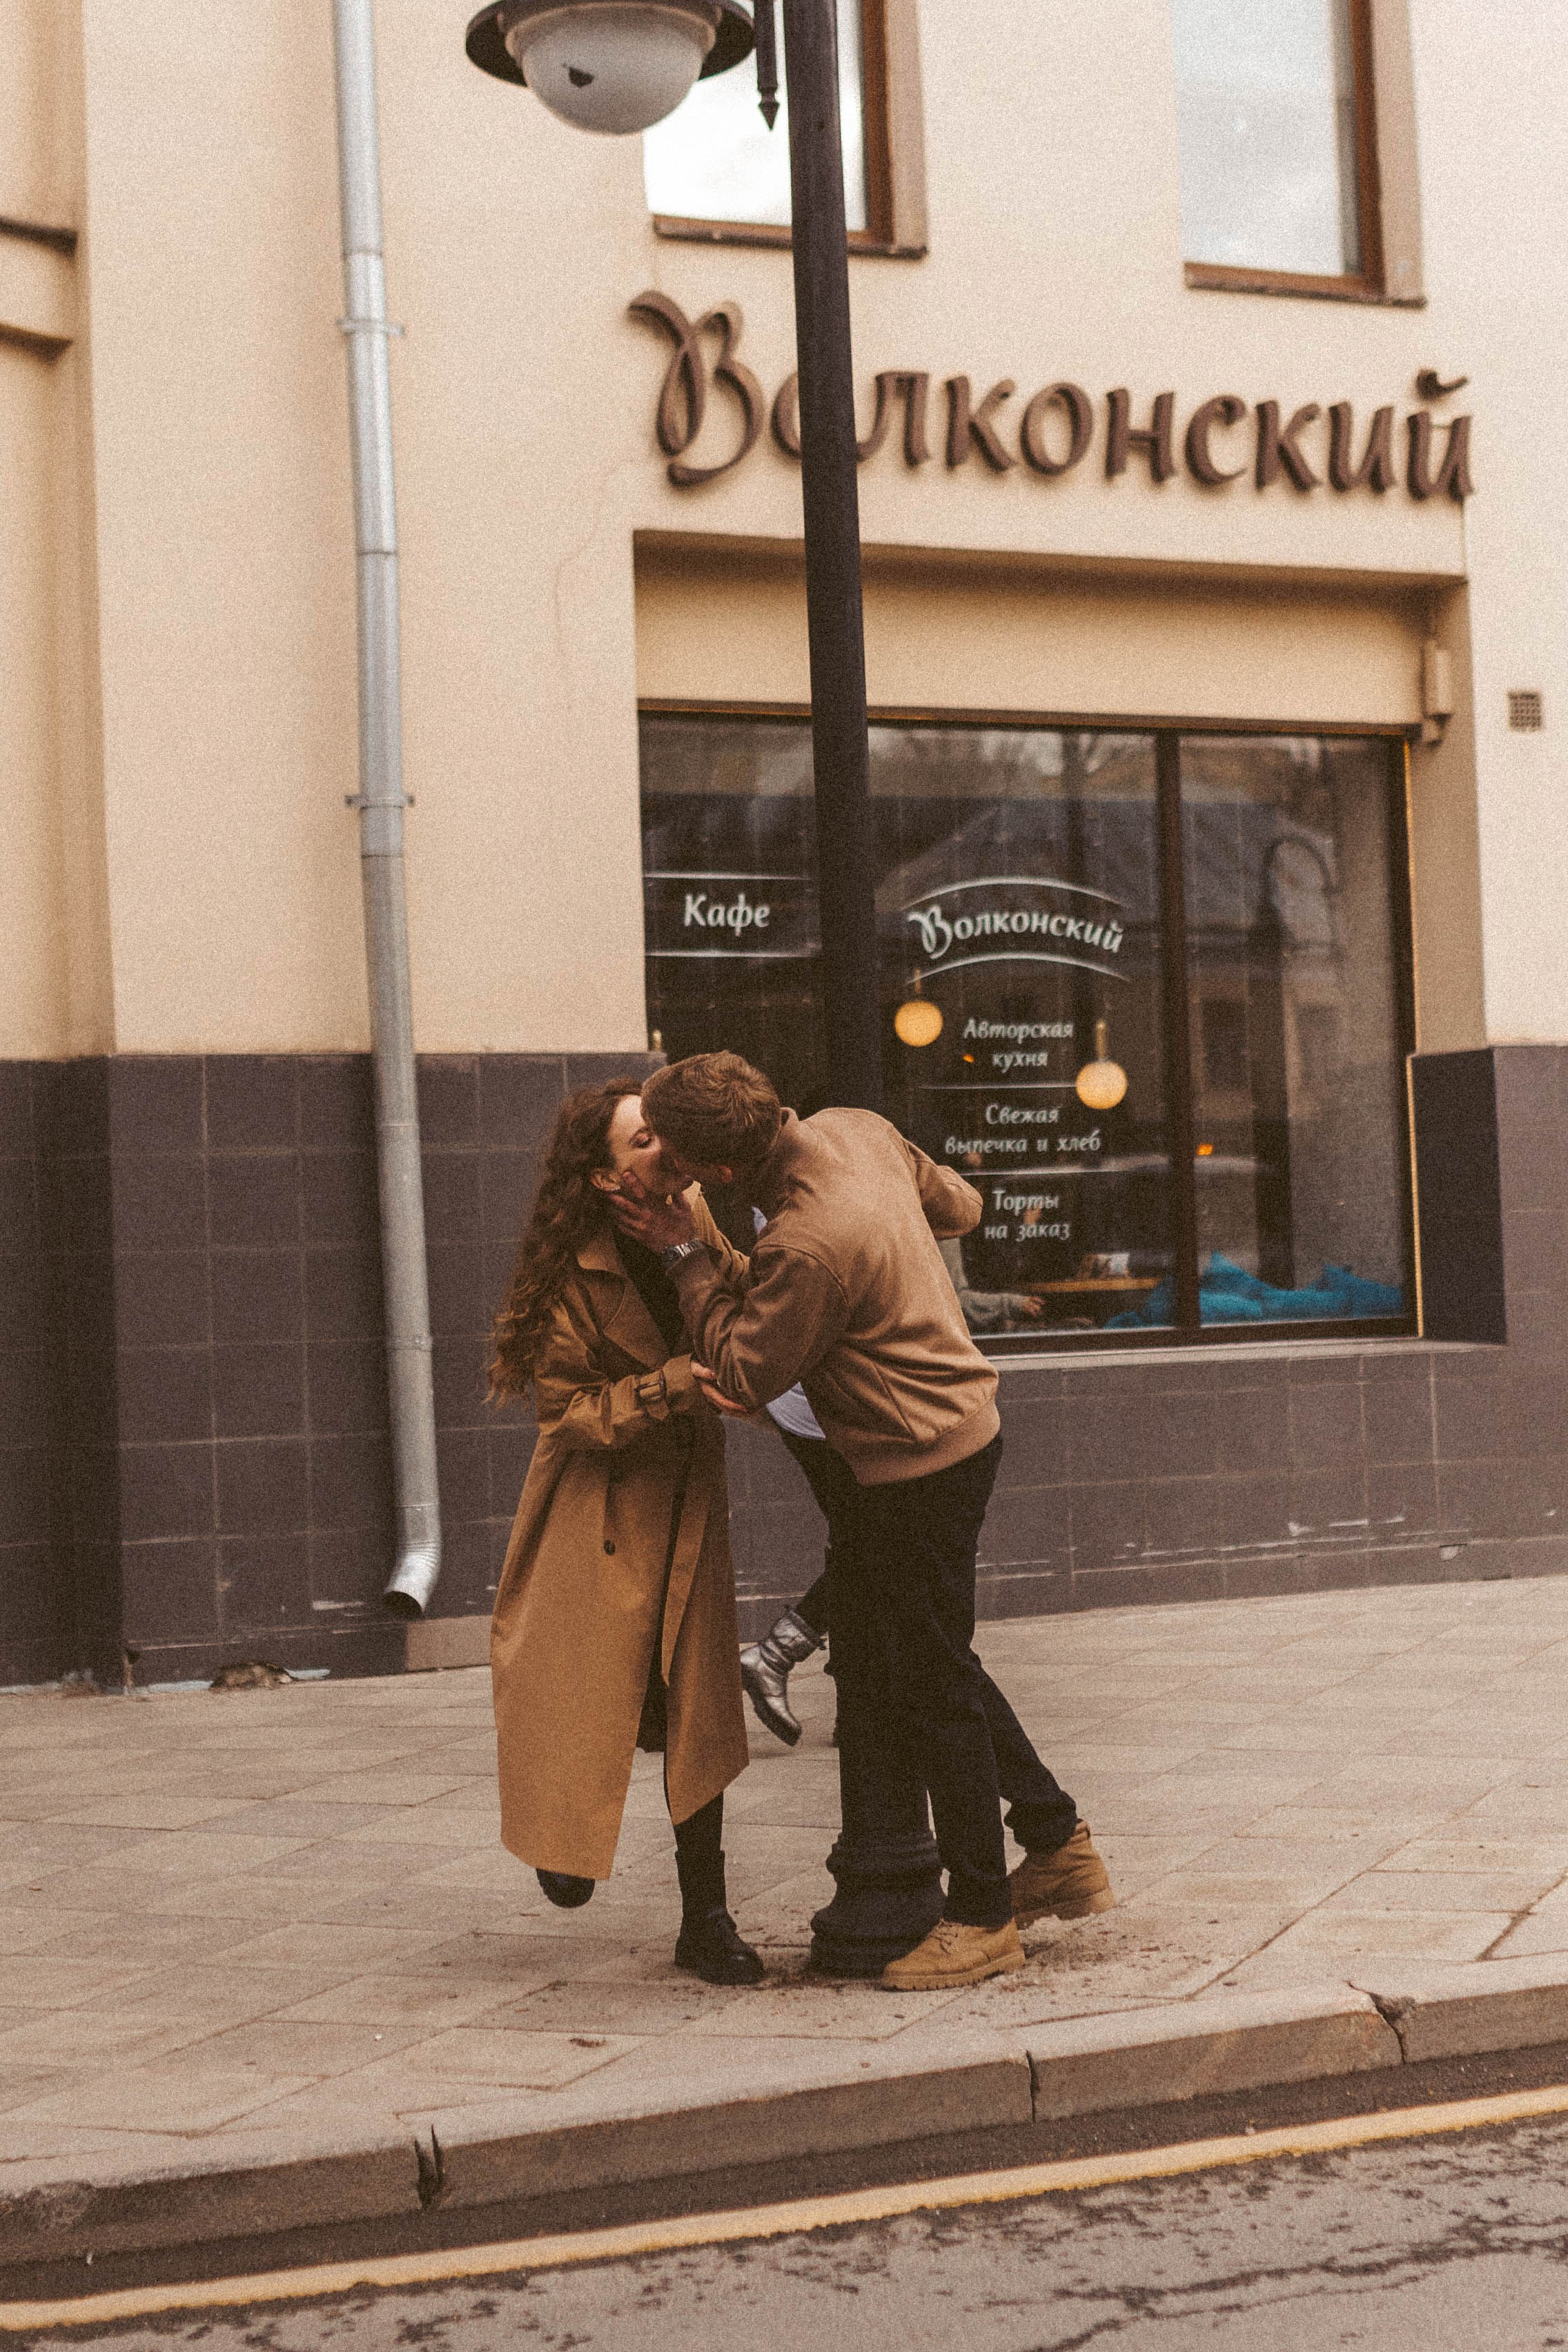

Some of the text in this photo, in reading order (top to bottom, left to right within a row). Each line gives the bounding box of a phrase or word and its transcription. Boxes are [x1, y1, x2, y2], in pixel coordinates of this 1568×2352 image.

[683, 894, 771, 937] Кафе
[908, 904, 1124, 959] Волконский
[963, 1017, 1074, 1044] Авторская
[992, 1051, 1048, 1073] кухня
[986, 1104, 1061, 1125] Свежая
[945, 1129, 1101, 1154] выпечка и хлеб
[992, 1189, 1059, 1216] Торты
[985, 1223, 1070, 1242] на заказ
